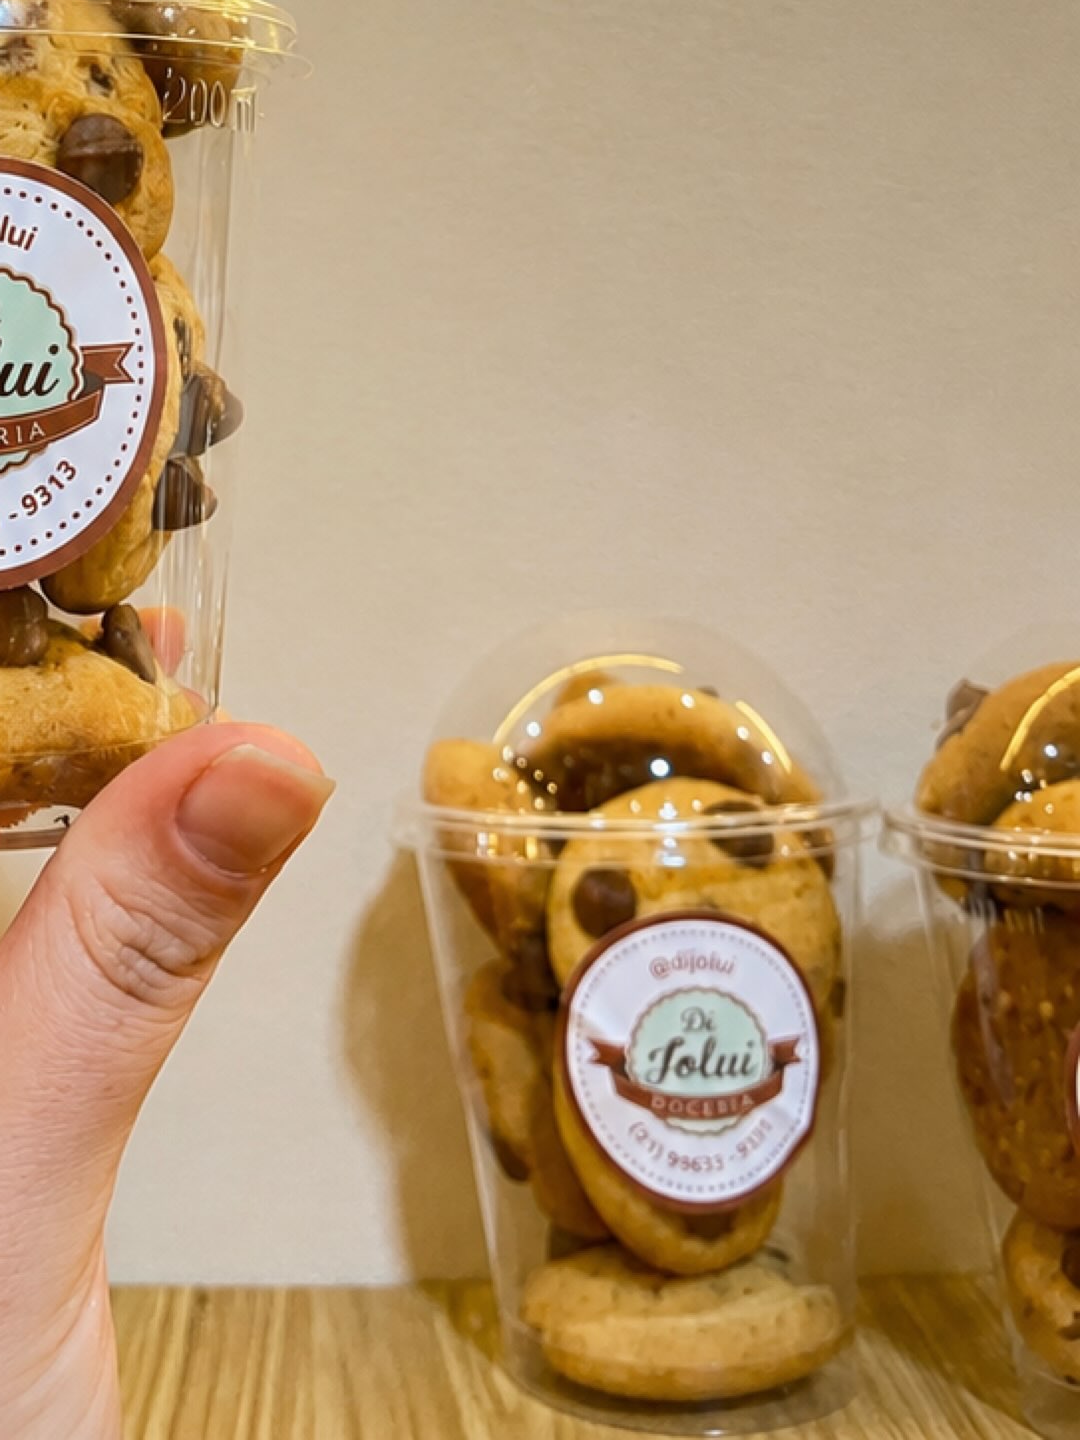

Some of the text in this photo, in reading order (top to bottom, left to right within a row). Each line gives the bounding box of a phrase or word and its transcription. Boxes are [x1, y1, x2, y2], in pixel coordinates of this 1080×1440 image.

[21, 460, 78, 516] 9313
[680, 1005, 717, 1033] Di
[645, 1036, 760, 1085] Jolui
